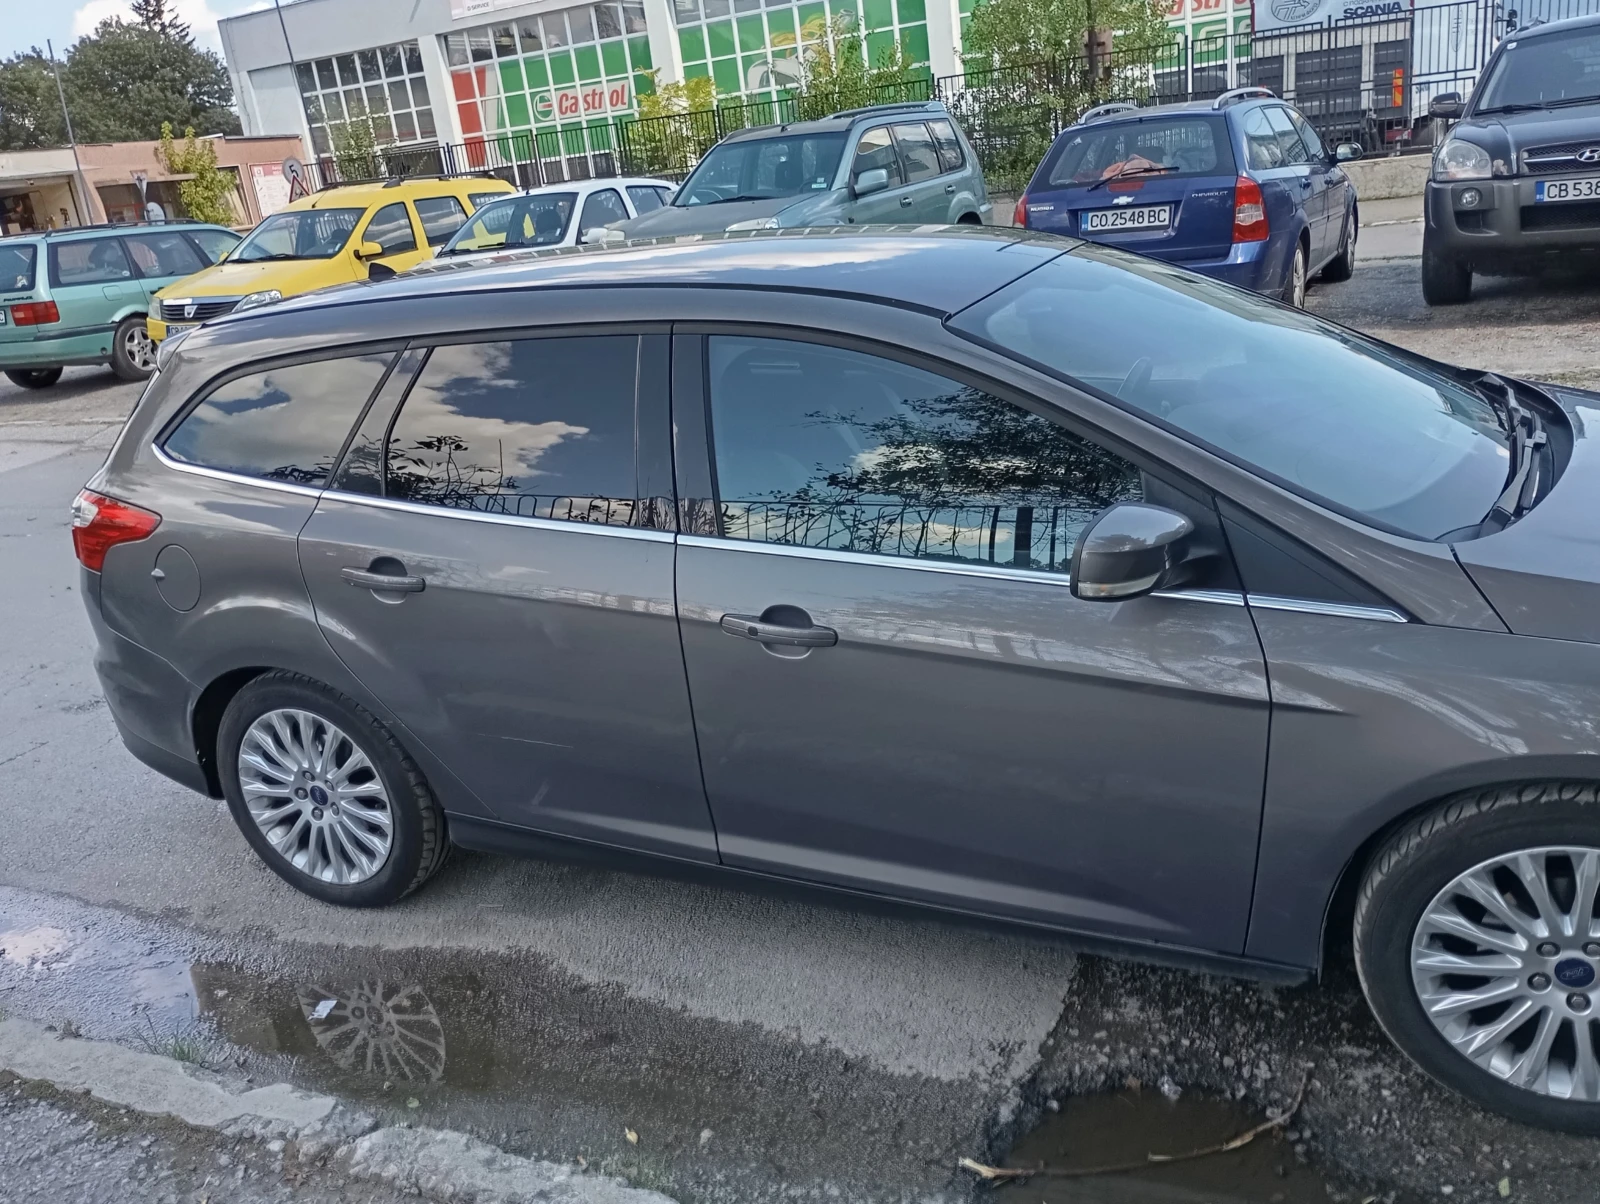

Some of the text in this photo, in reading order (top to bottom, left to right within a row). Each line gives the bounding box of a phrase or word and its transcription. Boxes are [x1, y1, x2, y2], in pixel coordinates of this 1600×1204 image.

[1343, 1, 1402, 19] SCANIA
[1547, 183, 1569, 199] CB
[1147, 208, 1167, 224] BC
